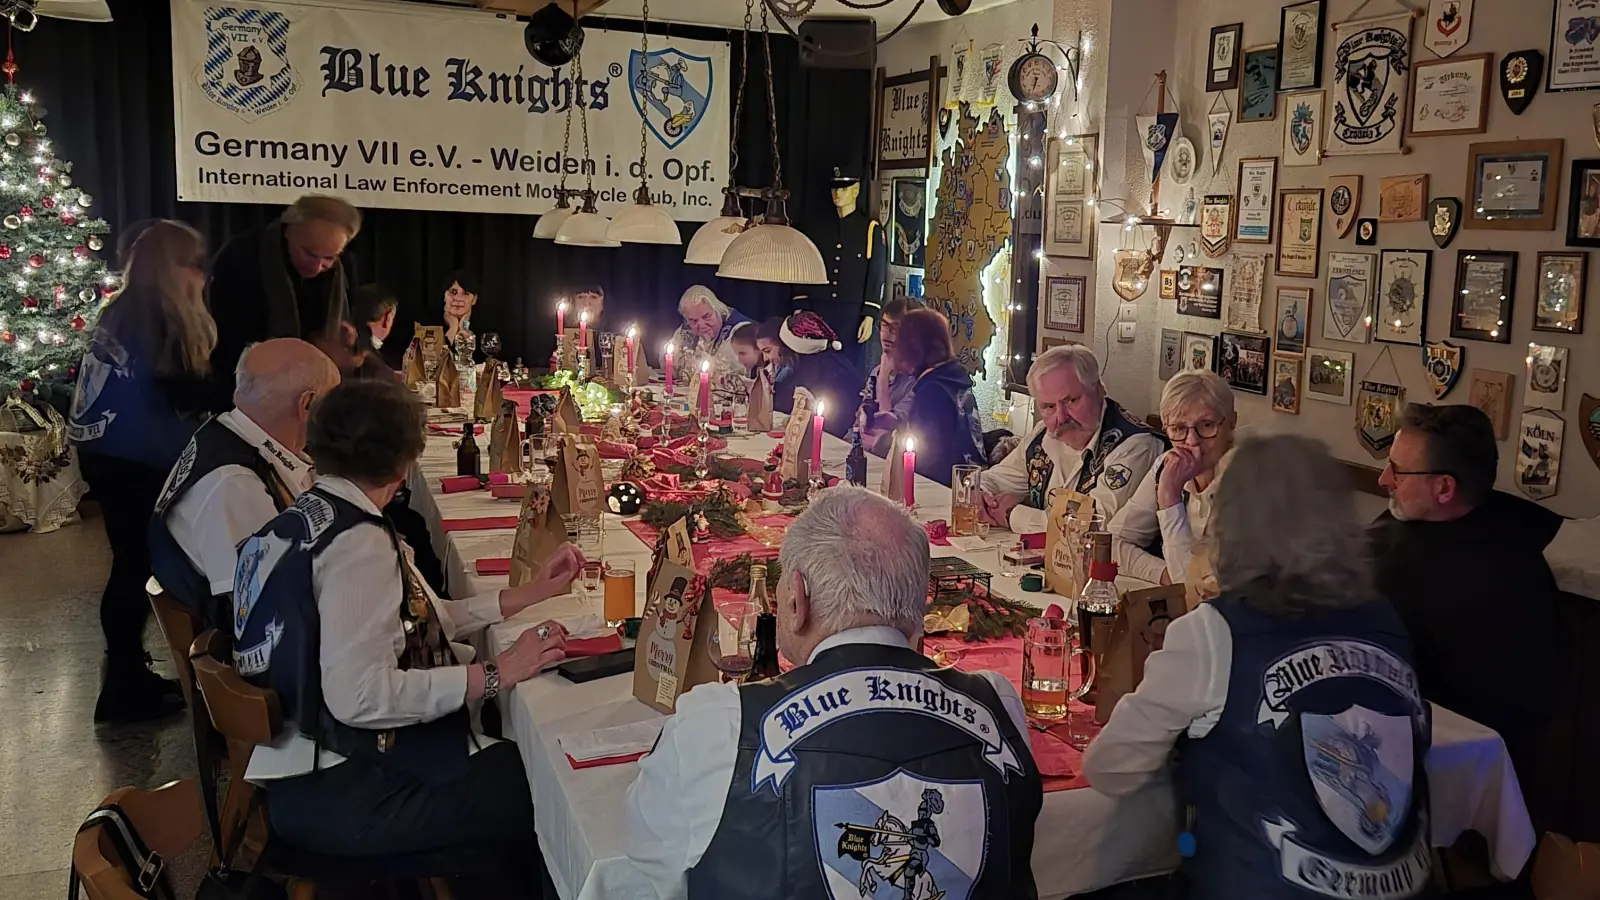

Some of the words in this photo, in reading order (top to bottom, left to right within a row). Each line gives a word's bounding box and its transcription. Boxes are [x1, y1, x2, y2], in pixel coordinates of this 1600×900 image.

[221, 21, 263, 34] Germany
[231, 33, 249, 42] VII
[319, 46, 430, 98] Blue
[1438, 71, 1472, 85] Urkunde
[255, 103, 278, 115] Weiden
[891, 88, 920, 119] Blue
[880, 126, 928, 157] Knights
[195, 130, 348, 167] Germany
[357, 139, 399, 166] VII
[409, 144, 462, 169] e.V.
[490, 147, 596, 176] Weiden
[605, 154, 620, 177] i.
[629, 157, 653, 179] d.
[662, 158, 715, 186] Opf.
[198, 167, 338, 189] International
[344, 173, 386, 192] Law
[393, 176, 522, 198] Enforcement
[682, 191, 713, 207] Inc.
[1525, 423, 1556, 443] KÖLN
[650, 641, 674, 667] Merry
[1266, 652, 1324, 699] Blue
[774, 686, 852, 739] Blue
[841, 840, 868, 852] Knights
[847, 833, 865, 843] Blue
